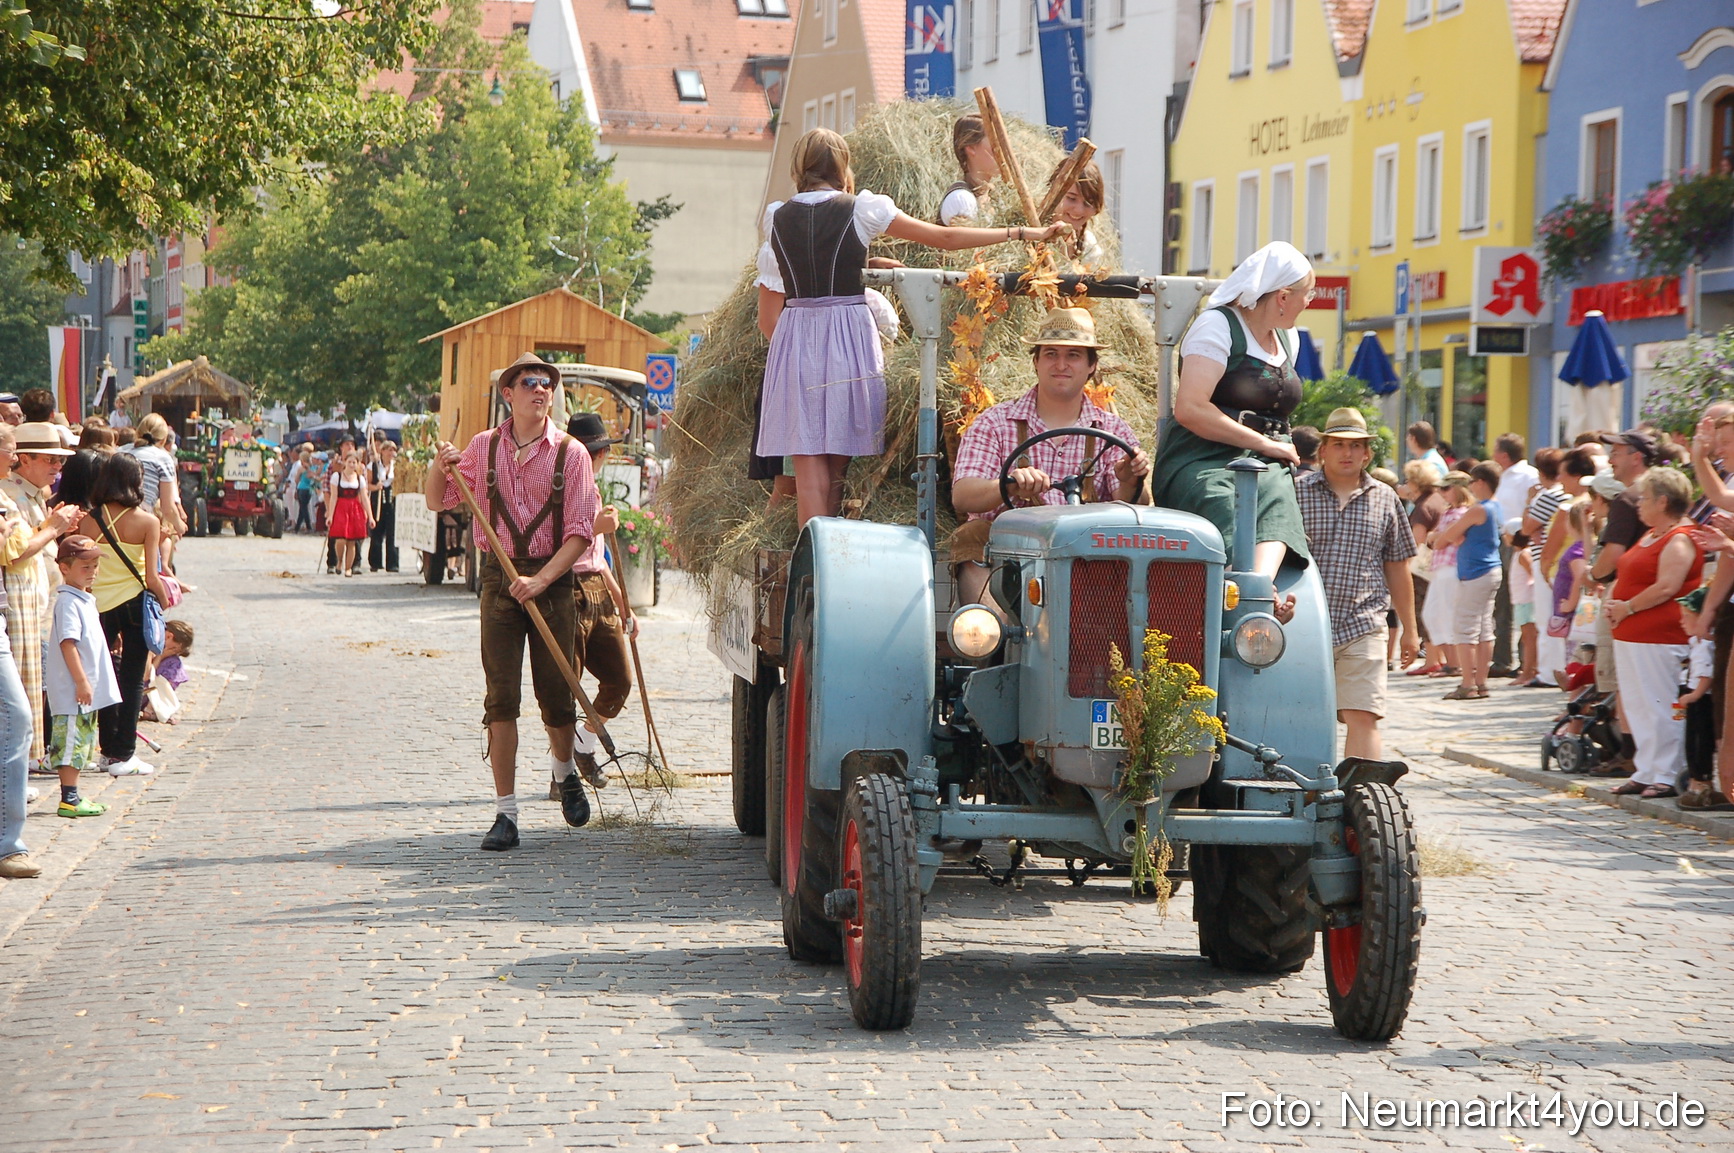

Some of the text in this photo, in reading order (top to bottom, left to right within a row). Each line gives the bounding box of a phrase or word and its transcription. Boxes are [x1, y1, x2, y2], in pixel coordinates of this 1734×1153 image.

[1249, 108, 1350, 157] HOTEL Lehmeier
[1397, 269, 1407, 309] P
[647, 392, 674, 407] TAXI
[227, 469, 256, 478] LAABER
[1091, 532, 1190, 551] Schlüter
